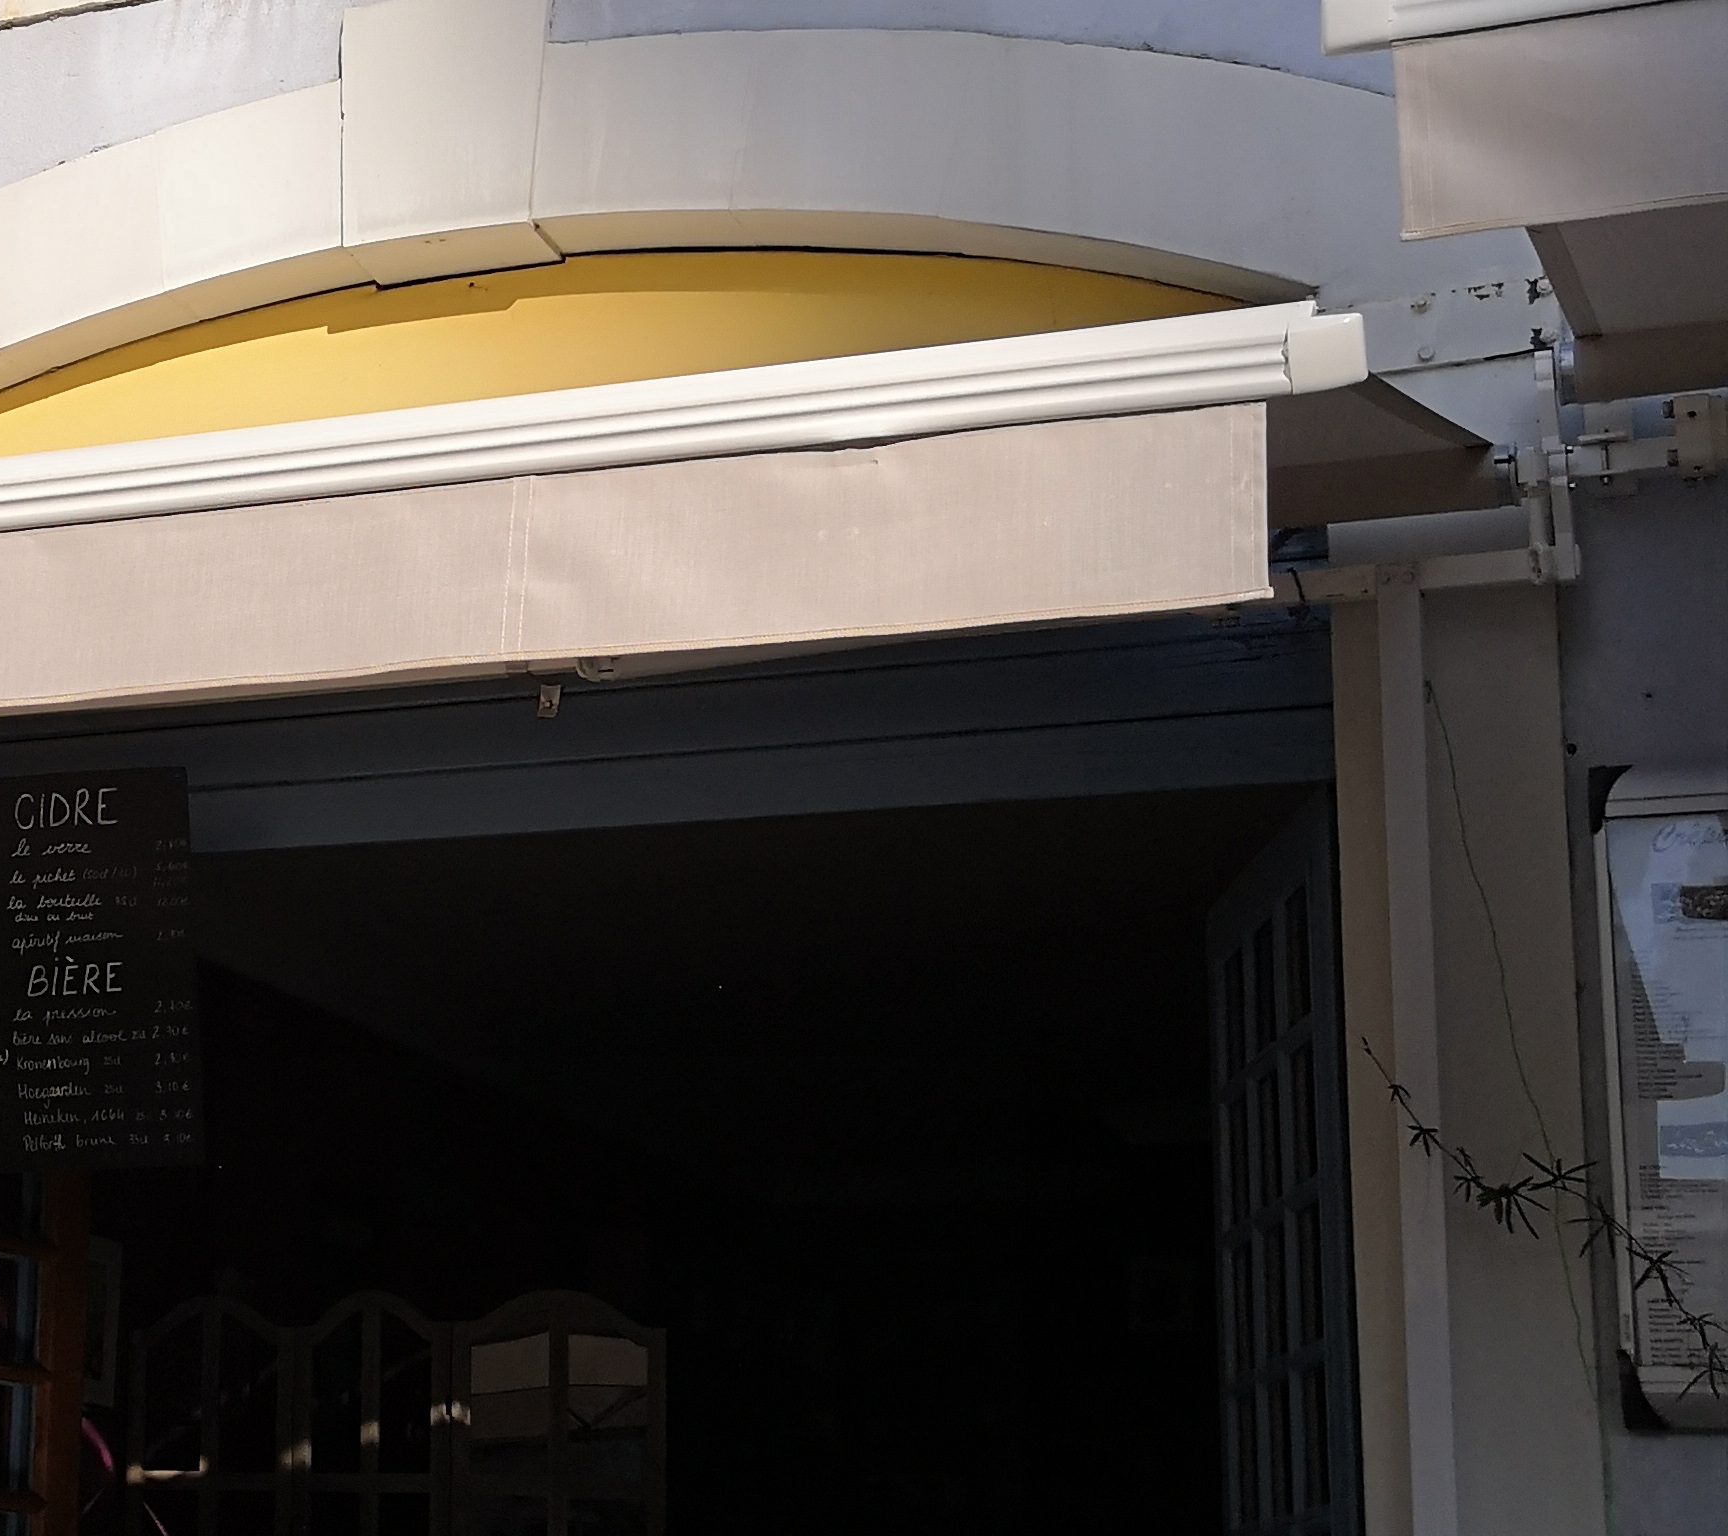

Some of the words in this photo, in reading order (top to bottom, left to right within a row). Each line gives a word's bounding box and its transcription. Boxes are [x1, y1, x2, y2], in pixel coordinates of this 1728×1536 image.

[14, 786, 119, 830] CIDRE
[10, 837, 31, 858] le
[41, 841, 92, 856] verre
[9, 869, 26, 885] le
[31, 866, 78, 891] pichet
[7, 896, 26, 910] la
[36, 893, 102, 909] bouteille
[11, 930, 61, 956] apéritif
[65, 932, 123, 945] maison
[27, 955, 123, 997] BIÈRE
[12, 1008, 33, 1022] la
[43, 1007, 117, 1026] pression
[12, 1030, 42, 1047] bière
[47, 1033, 72, 1046] sans
[82, 1030, 127, 1044] alcool
[75, 1133, 117, 1148] brune
